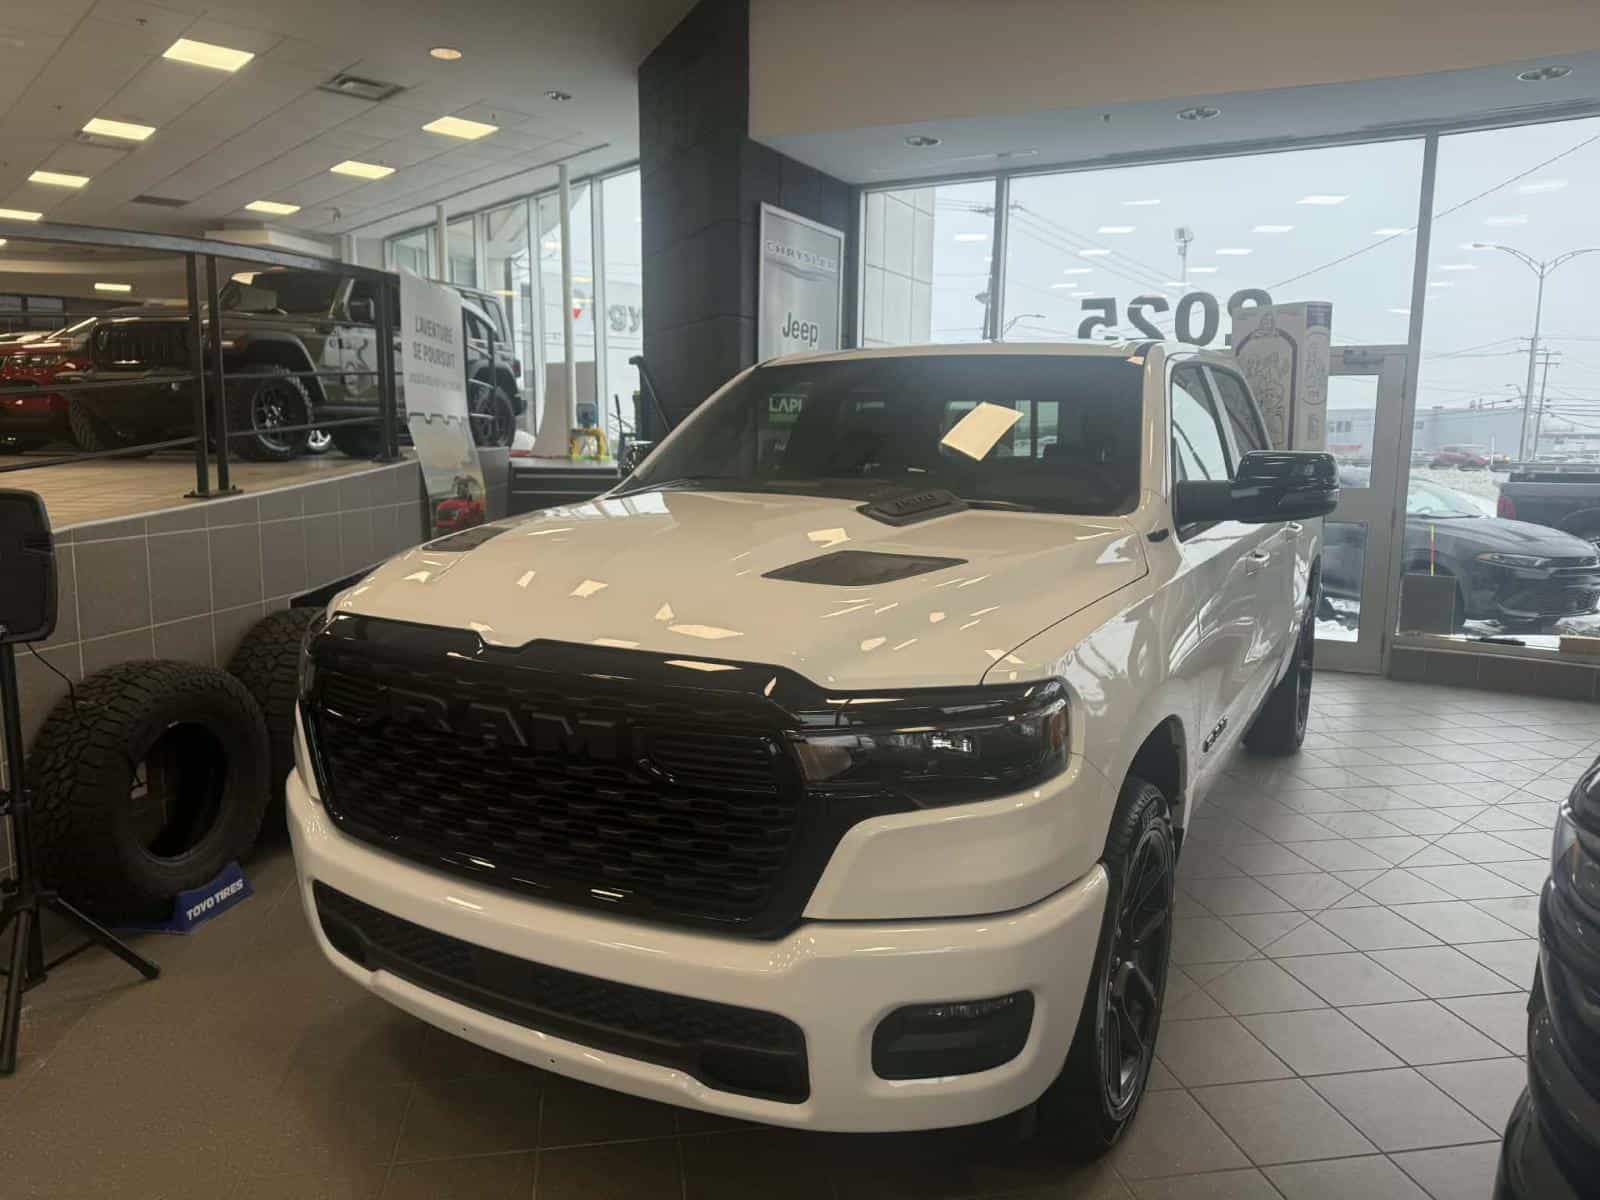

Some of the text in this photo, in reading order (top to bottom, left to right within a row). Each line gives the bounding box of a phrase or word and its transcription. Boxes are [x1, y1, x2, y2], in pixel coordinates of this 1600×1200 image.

[766, 240, 838, 272] CHRYSLER
[782, 311, 818, 347] Jeep
[214, 879, 244, 904] TIRES
